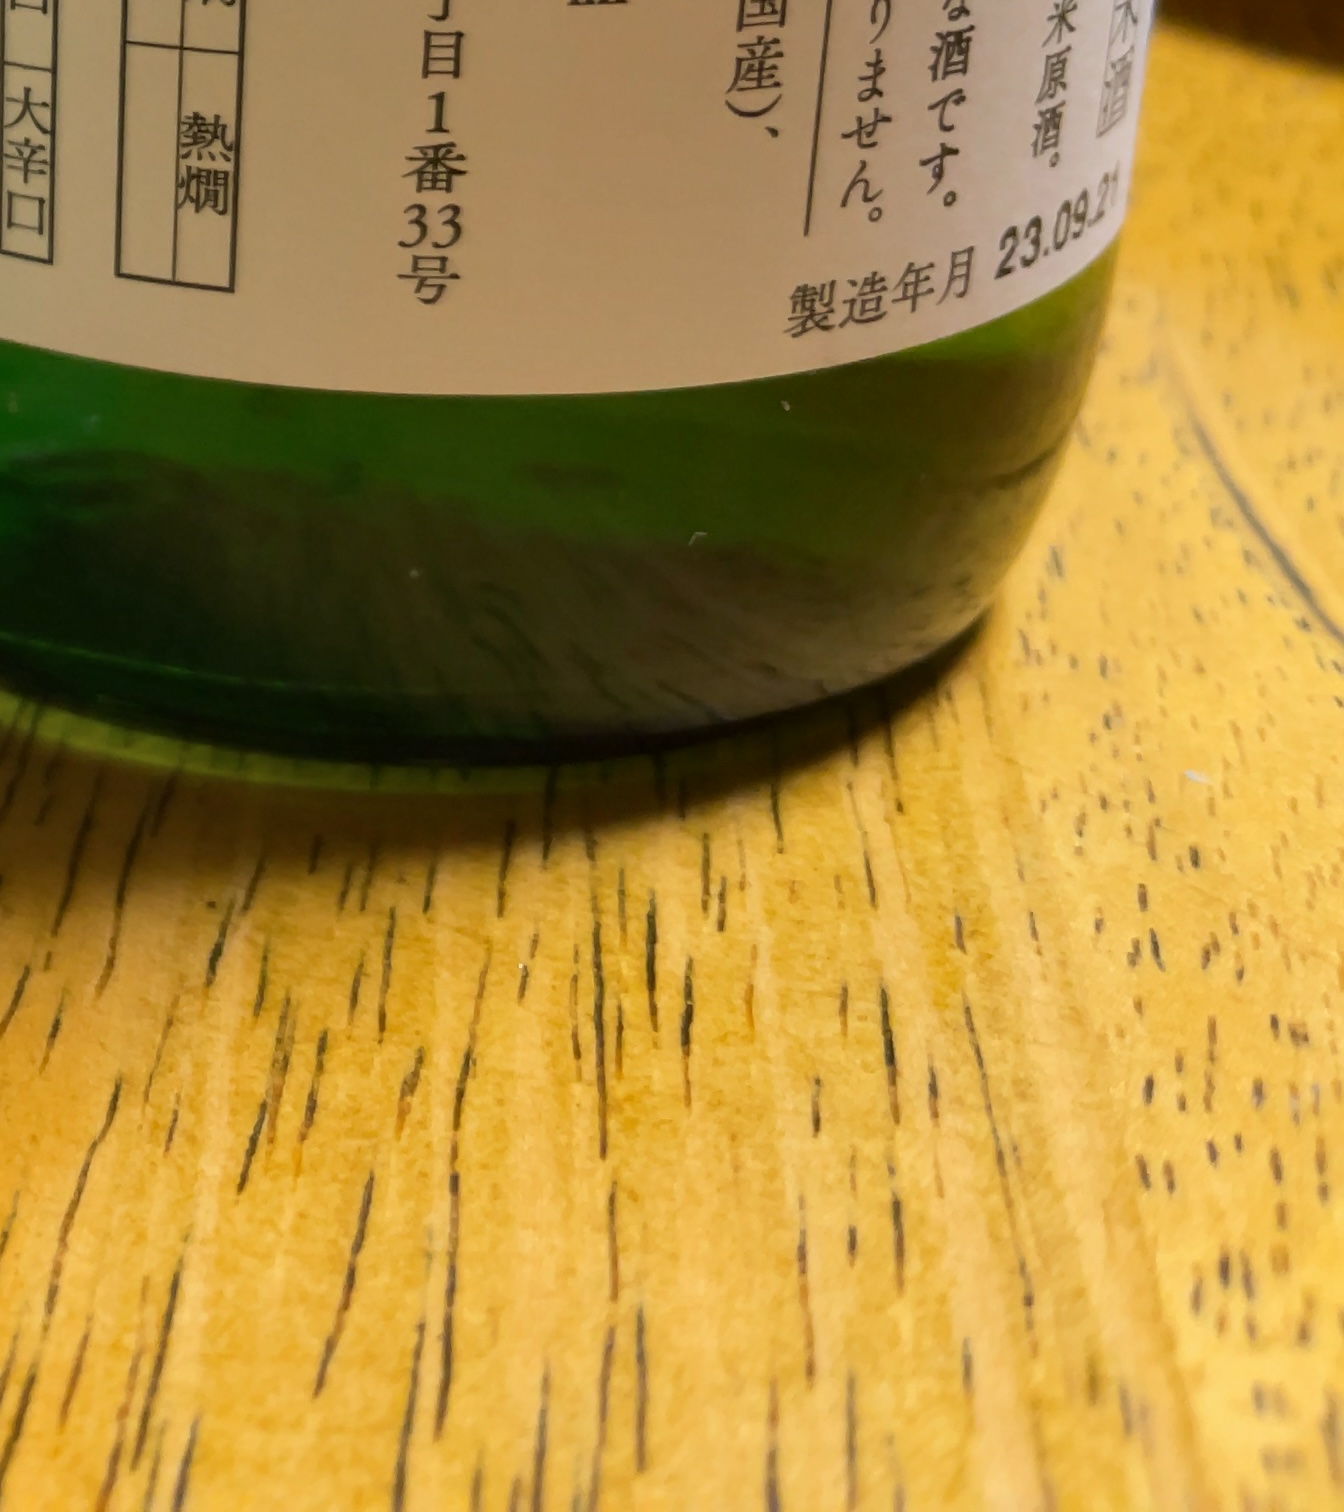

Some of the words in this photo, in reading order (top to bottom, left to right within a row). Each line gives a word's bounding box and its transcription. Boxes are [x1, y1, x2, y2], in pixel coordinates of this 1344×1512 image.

[4, 85, 51, 237] 大辛口
[176, 111, 234, 216] 熱燗
[784, 245, 976, 340] 製造年月
